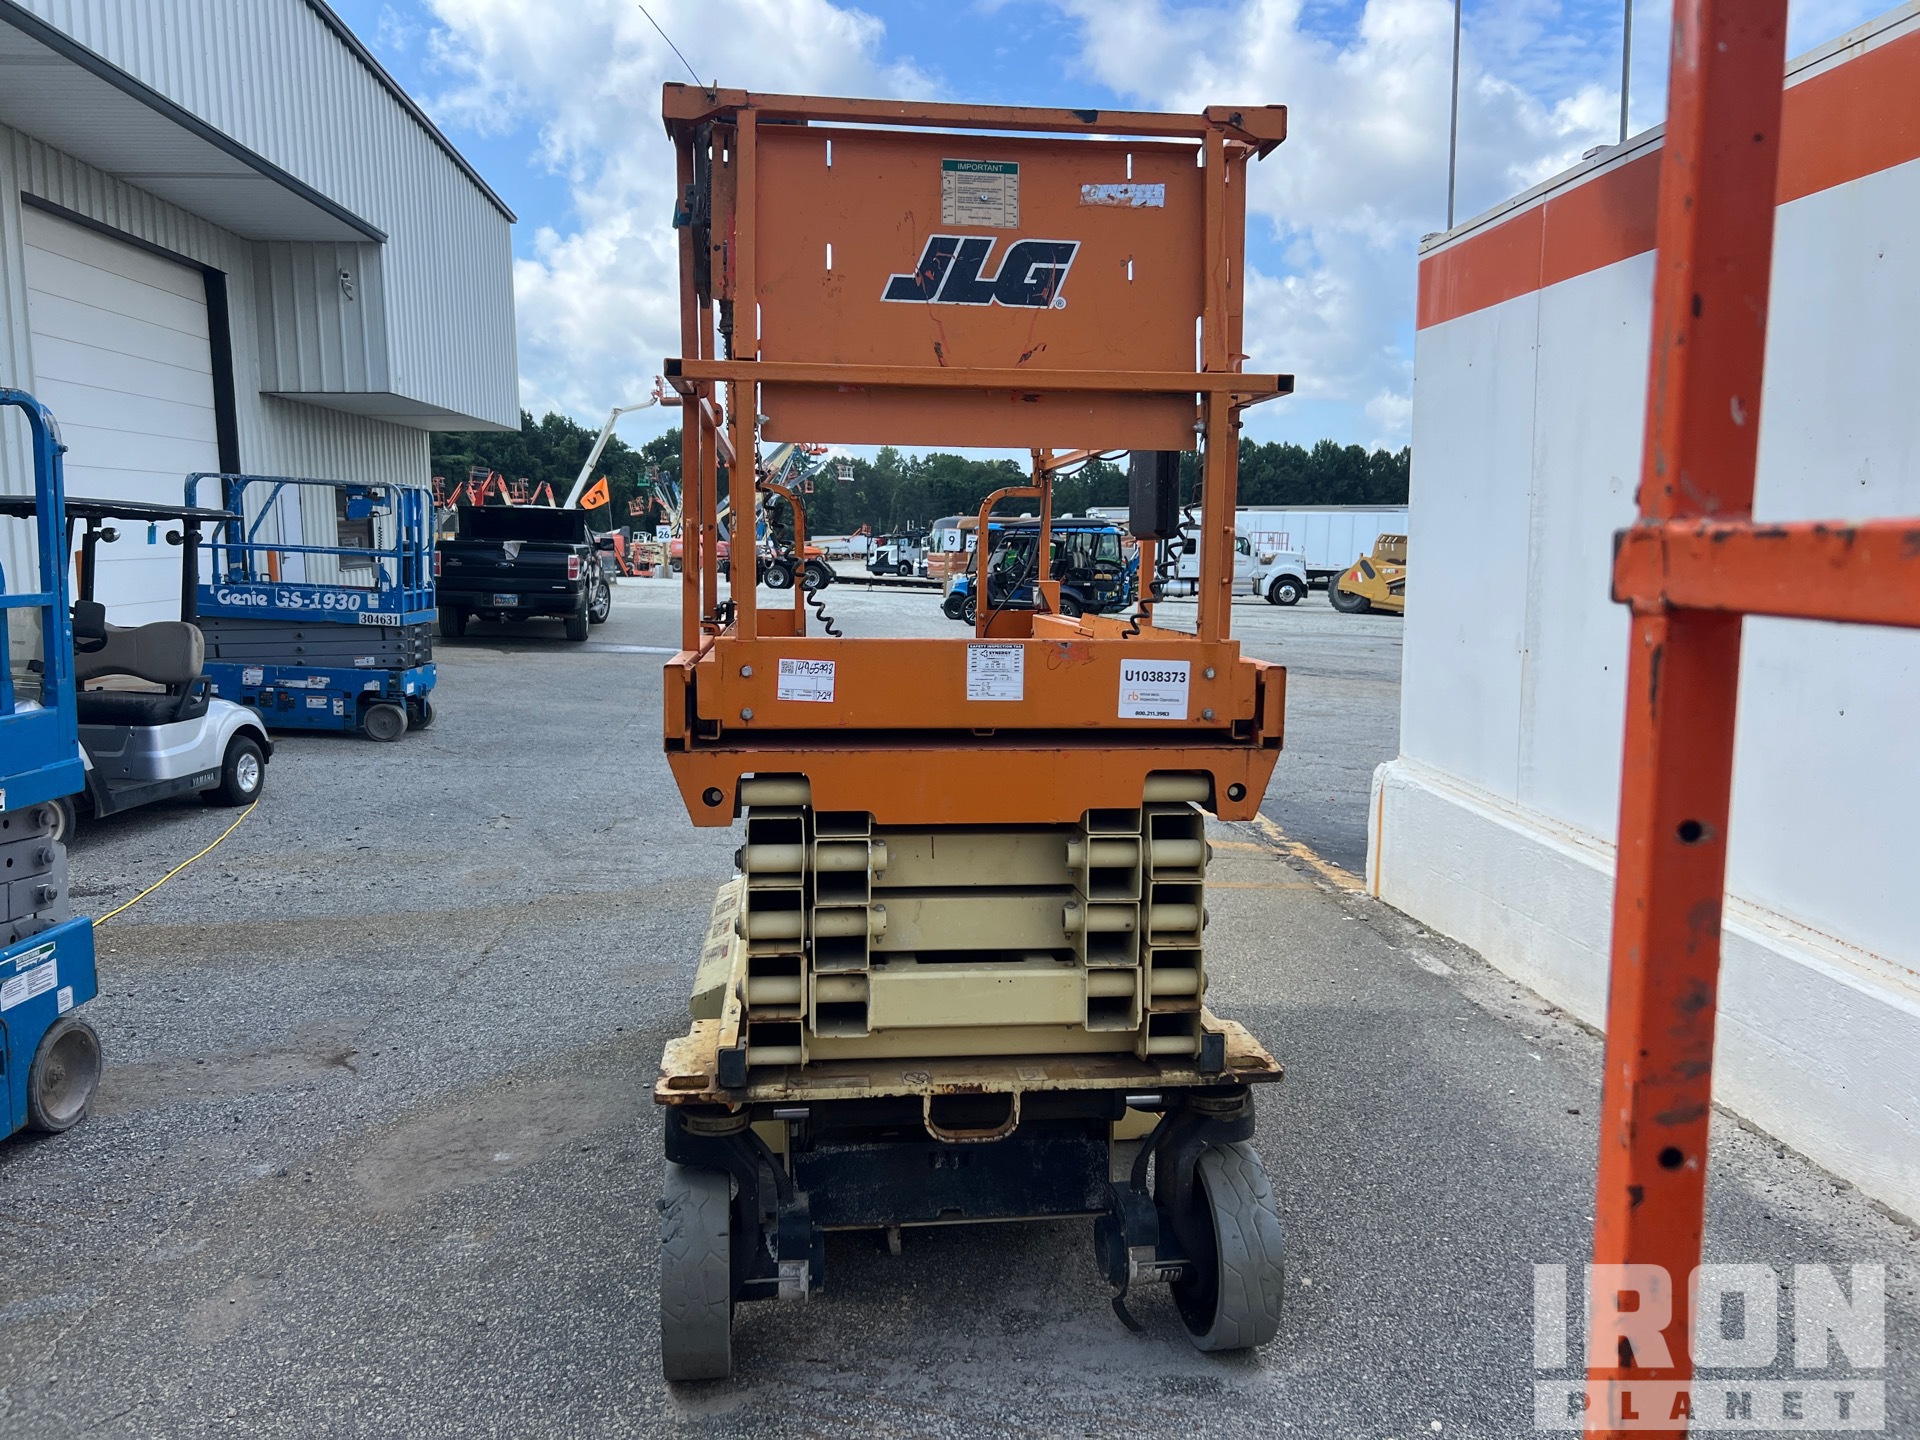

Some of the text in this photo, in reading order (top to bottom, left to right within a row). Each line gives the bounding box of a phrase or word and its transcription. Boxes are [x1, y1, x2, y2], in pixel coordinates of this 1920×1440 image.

[957, 163, 1004, 172] IMPORTANT
[880, 234, 1081, 309] JLG
[658, 530, 670, 539] 26
[949, 536, 955, 545] 9
[217, 588, 361, 611] Genie GS-1930
[360, 613, 399, 626] 304631
[1125, 670, 1186, 682] U1038373
[191, 771, 216, 787] YAMAHA
